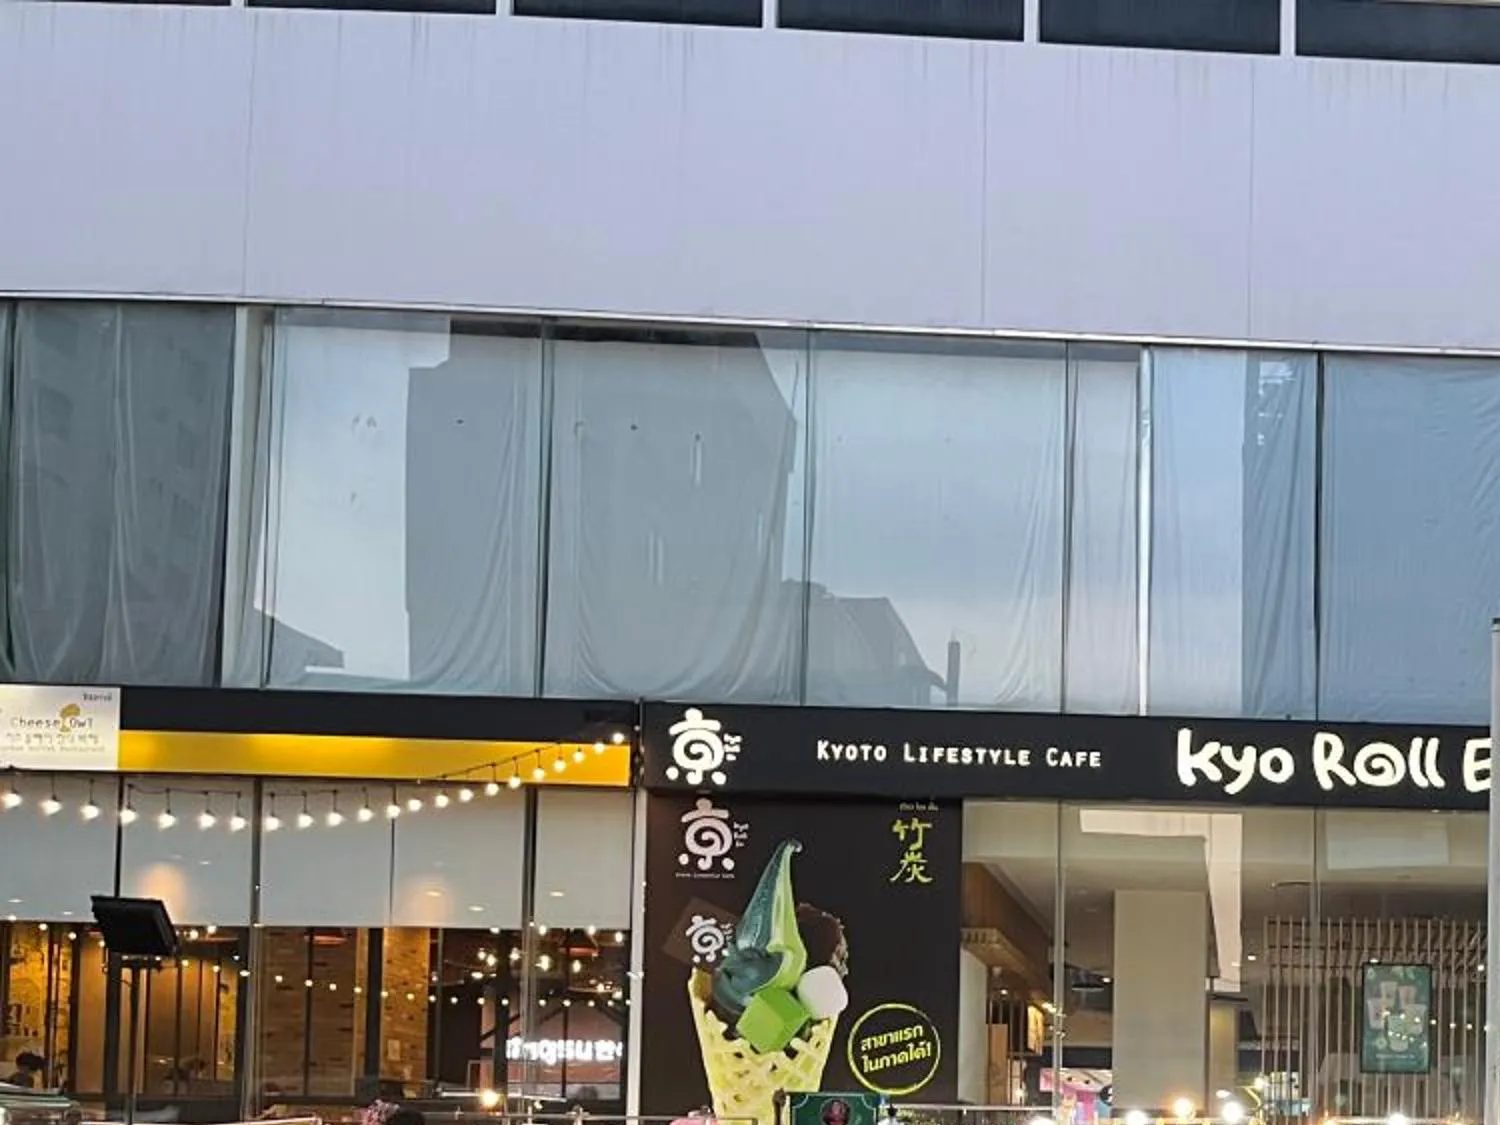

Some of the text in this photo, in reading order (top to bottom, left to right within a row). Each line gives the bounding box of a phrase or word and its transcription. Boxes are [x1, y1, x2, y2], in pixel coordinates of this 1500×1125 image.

[816, 739, 1101, 767] KYOTO LIFESTYLE CAFE
[1312, 731, 1446, 790] Roll
[861, 1024, 923, 1051] สาขาแรก
